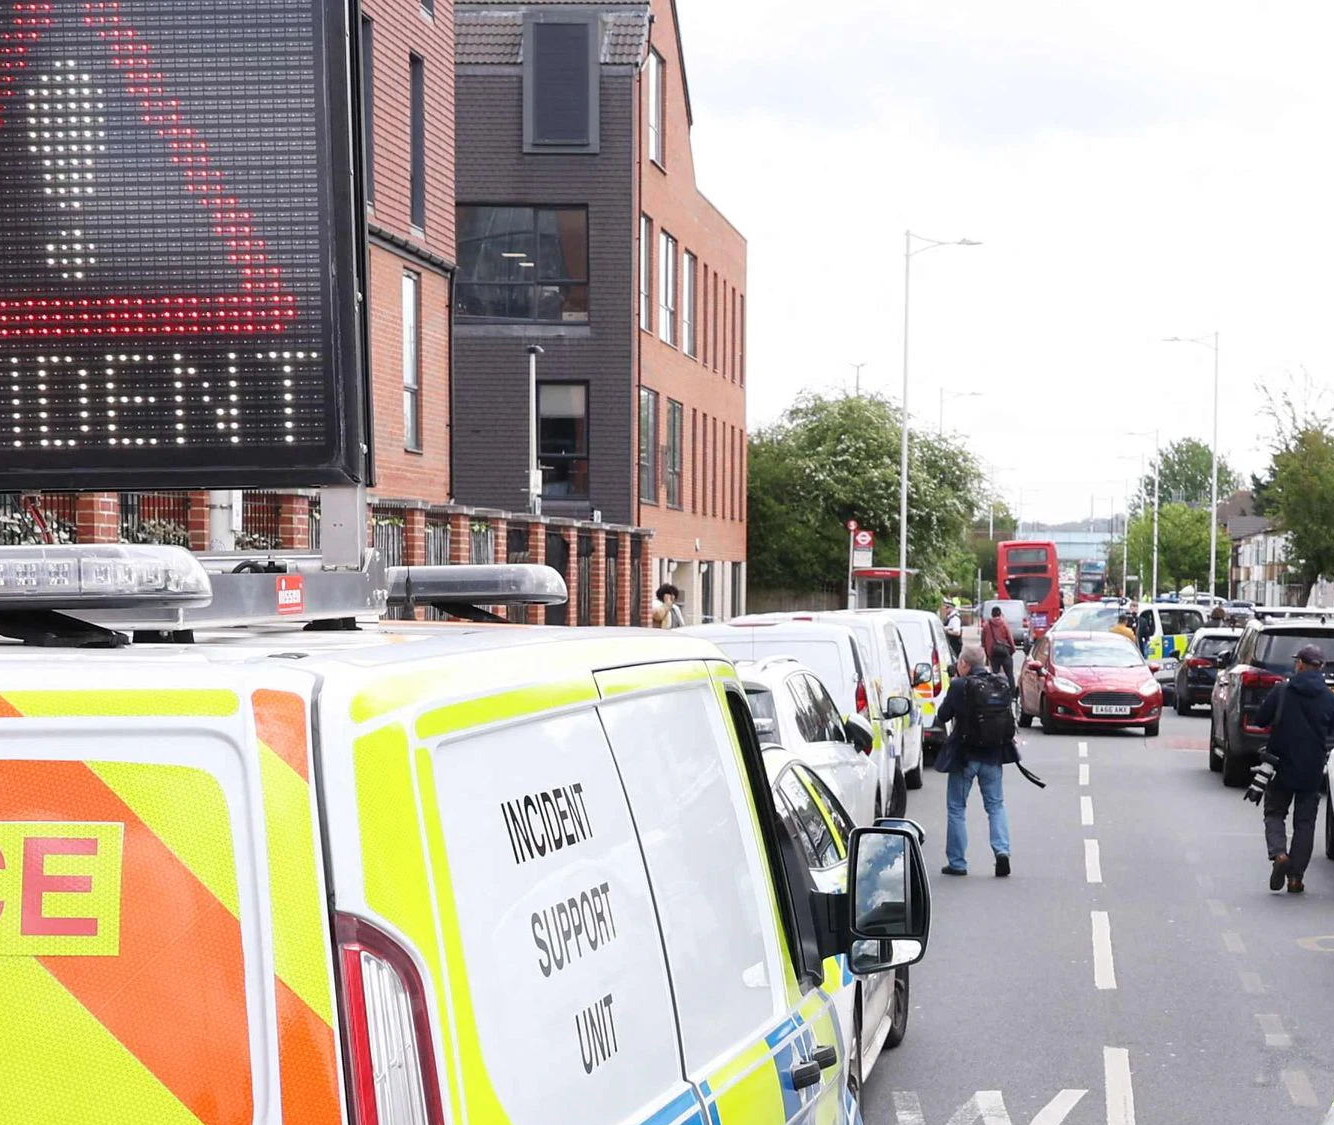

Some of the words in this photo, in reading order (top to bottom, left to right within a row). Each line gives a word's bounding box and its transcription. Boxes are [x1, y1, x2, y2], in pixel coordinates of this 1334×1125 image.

[500, 782, 593, 865] INCIDENT
[531, 881, 617, 978] SUPPORT
[575, 993, 618, 1075] UNIT
